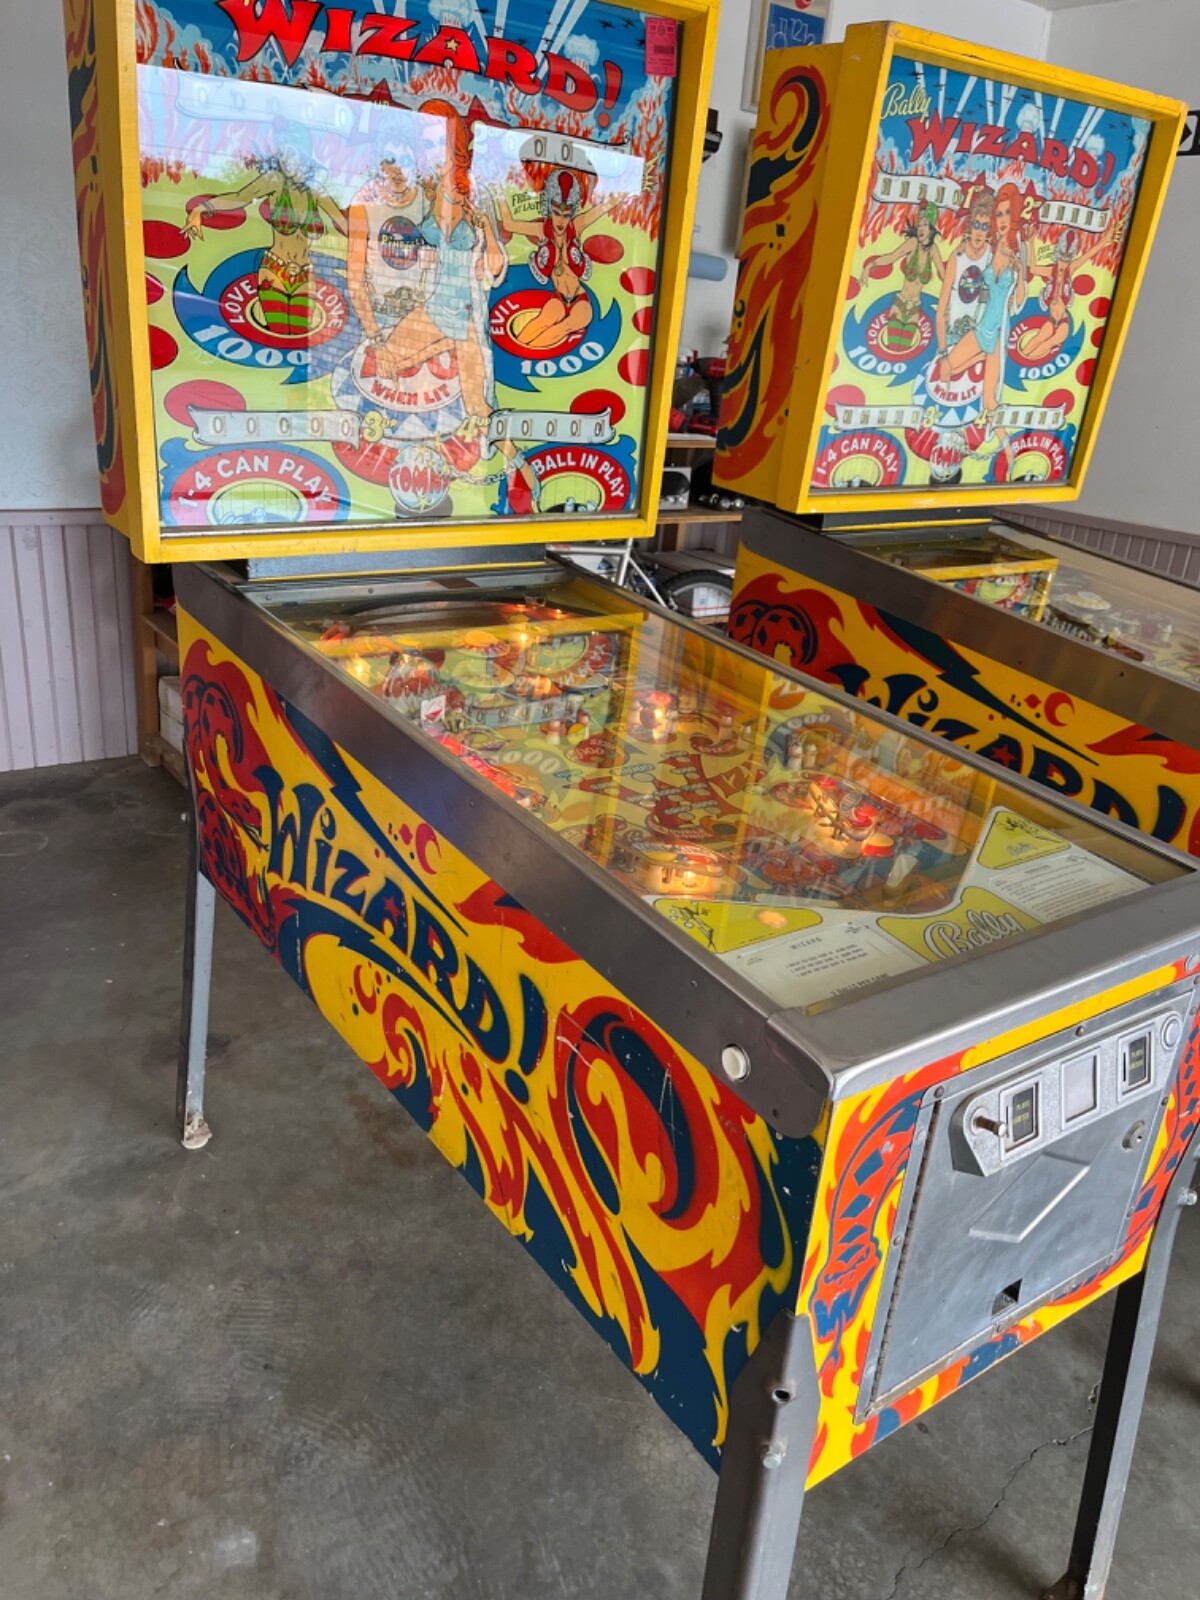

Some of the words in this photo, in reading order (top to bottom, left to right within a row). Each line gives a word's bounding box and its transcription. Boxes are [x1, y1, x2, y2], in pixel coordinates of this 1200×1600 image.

[217, 0, 622, 129] WIZARD!
[881, 82, 932, 123] Bally
[906, 108, 1115, 197] WIZARD!
[225, 279, 257, 323] LOVE
[316, 285, 345, 329] LOVE
[491, 299, 520, 336] EVIL
[193, 324, 311, 366] 1000
[868, 312, 888, 346] LOVE
[918, 316, 933, 346] LOVE
[1007, 322, 1028, 350] EVIL
[521, 341, 604, 378] 1000
[848, 345, 907, 375] 1000
[1019, 352, 1070, 379] 1000
[424, 384, 449, 405] LIT
[840, 438, 869, 455] CAN
[872, 439, 898, 473] PLAY
[1013, 438, 1038, 452] BALL
[1038, 439, 1052, 450] IN
[1049, 444, 1063, 472] PLAY
[217, 455, 270, 478] CAN
[278, 458, 333, 503] PLAY
[531, 452, 577, 475] BALL
[580, 453, 599, 469] IN
[598, 461, 624, 497] PLAY
[924, 909, 1025, 958] Bally
